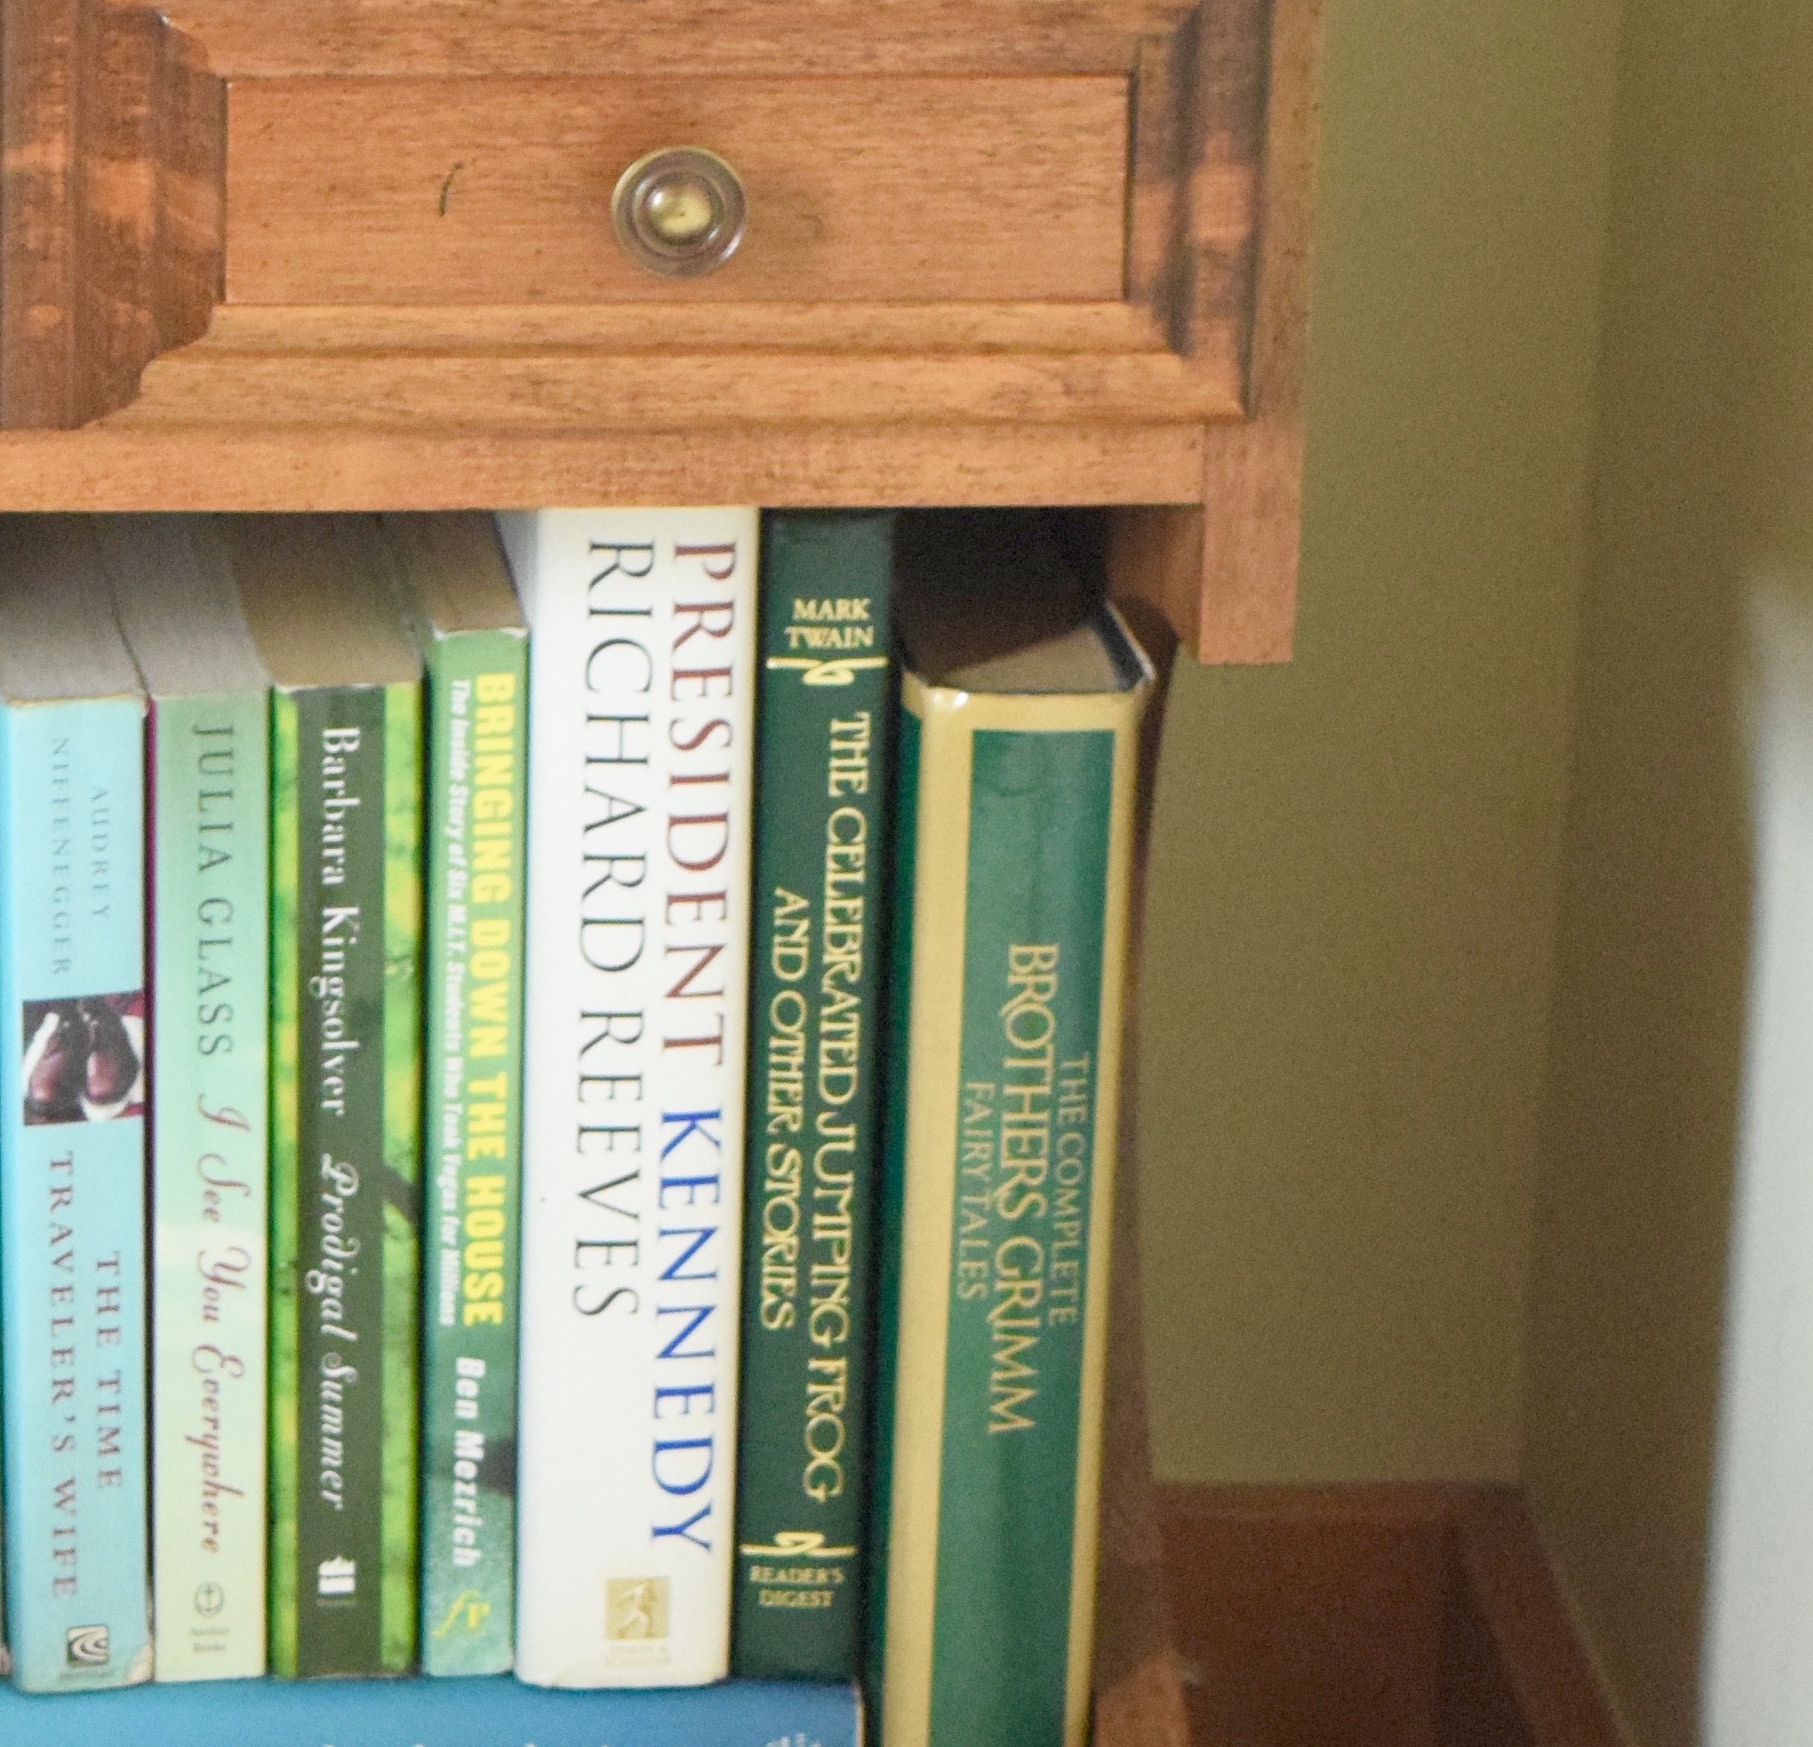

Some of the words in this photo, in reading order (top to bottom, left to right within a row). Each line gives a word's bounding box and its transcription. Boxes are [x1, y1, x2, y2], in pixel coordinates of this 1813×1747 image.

[785, 624, 875, 651] TWAIN
[792, 597, 872, 622] MARK
[449, 716, 471, 782] Inside
[450, 678, 472, 716] The
[579, 538, 656, 974] RICHARD
[827, 710, 872, 797] THE
[192, 722, 236, 874] JULIA
[320, 726, 362, 888] Barbara
[443, 783, 470, 840] Story
[471, 671, 516, 905] BRINGING
[661, 539, 739, 1067] PRESIDENT
[49, 735, 75, 976] NIFFENEGGER
[89, 783, 112, 921] AUDREY
[446, 841, 469, 867] of
[446, 867, 468, 901] Six
[196, 896, 236, 1058] GLASS
[469, 917, 512, 1058] DOWN
[771, 886, 811, 983] AND
[817, 806, 869, 1106] CELEBRATED
[307, 905, 362, 1118] Kingsolver
[442, 960, 467, 1054] Students
[765, 991, 808, 1133] OTHER
[196, 1091, 253, 1134] I
[441, 1101, 463, 1149] Took
[442, 1055, 465, 1099] Who
[466, 1070, 508, 1162] THE
[960, 1079, 996, 1190] FAIRY
[998, 940, 1061, 1221] BROTHERS
[1059, 1052, 1090, 1133] THE
[195, 1151, 254, 1225] See
[436, 1153, 462, 1212] Vegas
[572, 1007, 646, 1318] REEVES
[196, 1244, 254, 1324] You
[305, 1151, 362, 1343] Prodigal
[438, 1247, 461, 1328] Millions
[440, 1214, 462, 1246] for
[461, 1173, 507, 1328] HOUSE
[760, 1141, 804, 1331] STORIES
[808, 1113, 857, 1348] JUMPING
[956, 1193, 991, 1302] TALES
[1047, 1133, 1087, 1328] COMPLETE
[47, 1149, 78, 1454] TRAVELER'S
[94, 1249, 123, 1348] THE
[649, 1107, 724, 1554] KENNEDY
[987, 1234, 1046, 1436] GRIMM
[96, 1367, 124, 1489] TIME
[184, 1341, 247, 1556] Everywhere
[318, 1351, 359, 1512] Summer
[453, 1356, 487, 1419] Ben
[802, 1356, 847, 1503] FROG
[51, 1475, 80, 1598] WIFE
[450, 1428, 487, 1568] Mezrich
[749, 1565, 845, 1585] READER'S
[758, 1588, 834, 1609] DIGEST
